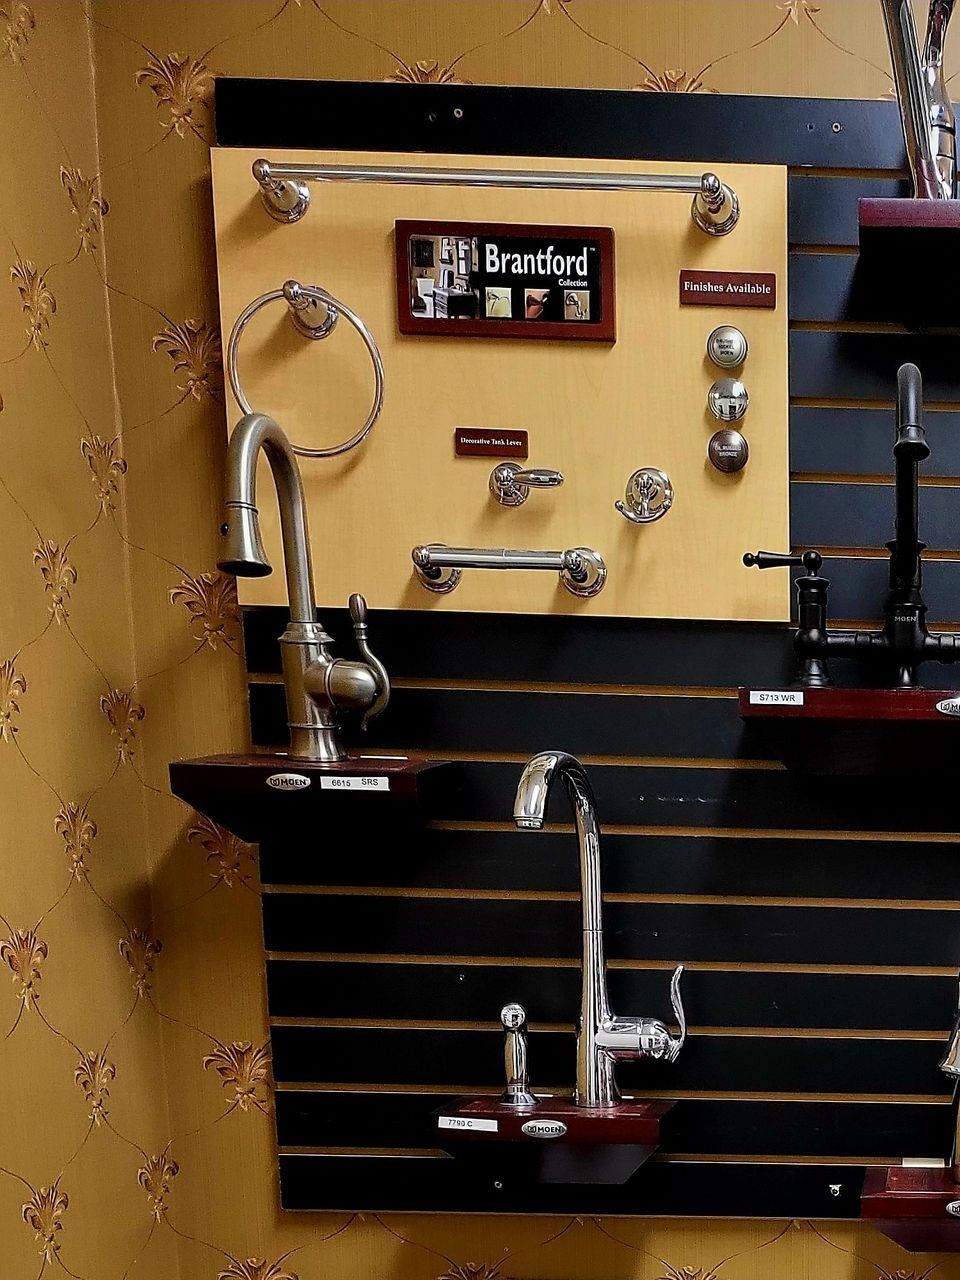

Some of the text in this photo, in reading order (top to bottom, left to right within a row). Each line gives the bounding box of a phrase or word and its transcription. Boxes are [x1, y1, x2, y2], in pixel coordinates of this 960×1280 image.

[485, 243, 588, 276] Brantford
[558, 279, 588, 287] Collection
[684, 281, 772, 294] Finishes Available
[460, 436, 522, 447] Decorative Tank Lever
[759, 694, 796, 702] S713 WR
[281, 779, 307, 787] MOEN
[361, 778, 379, 786] SRS
[537, 1125, 561, 1133] MOEN
